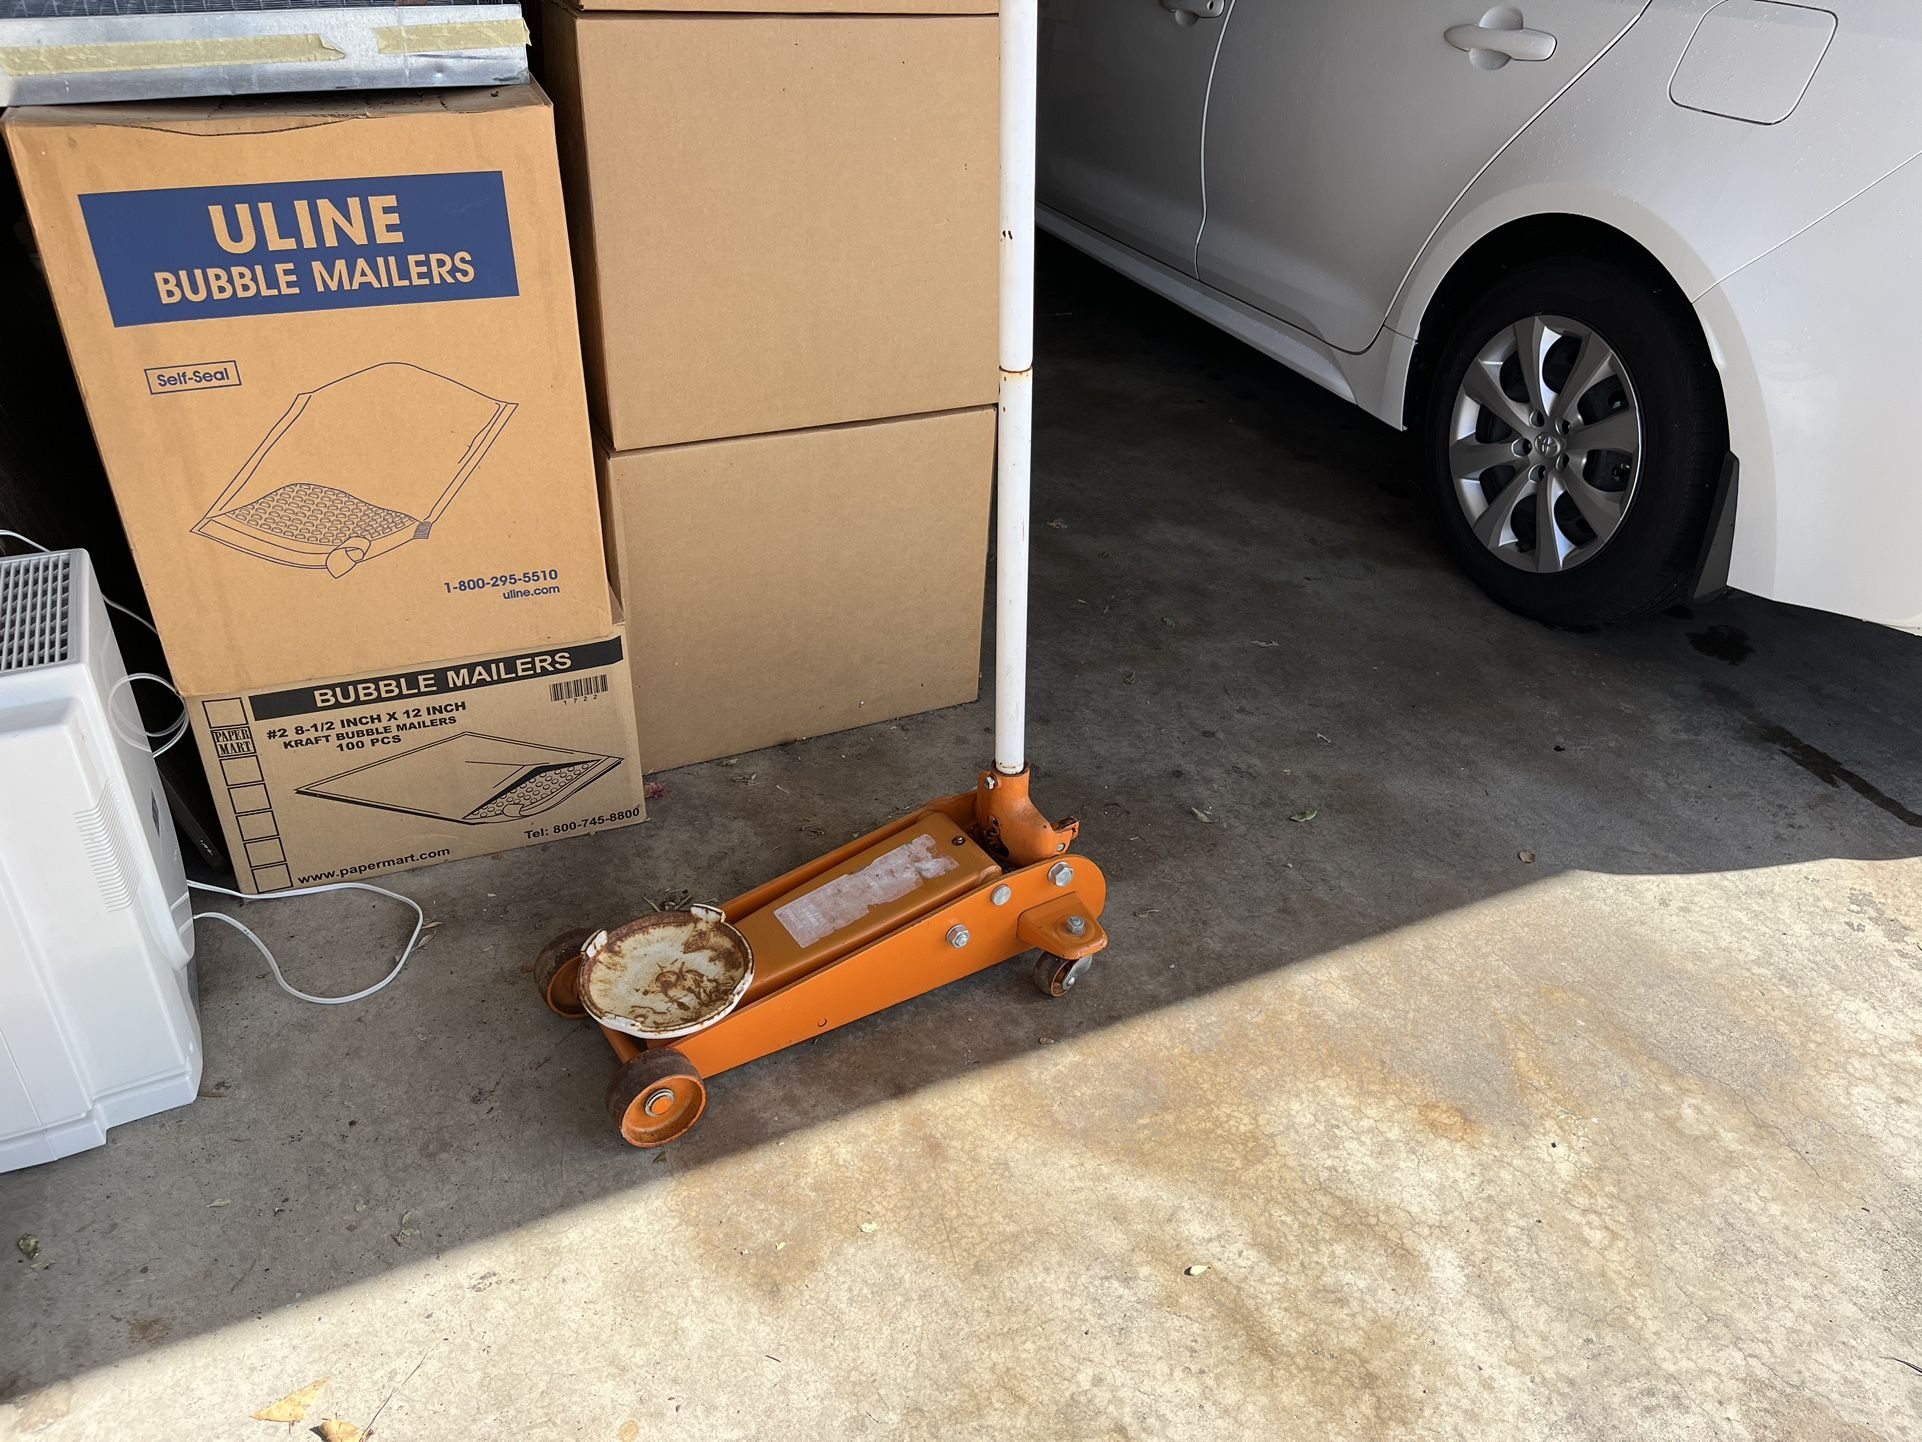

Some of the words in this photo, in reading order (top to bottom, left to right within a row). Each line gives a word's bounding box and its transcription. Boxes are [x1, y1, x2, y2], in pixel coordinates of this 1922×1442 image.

[208, 195, 404, 254] ULINE
[154, 263, 300, 304] BUBBLE
[311, 251, 475, 292] MAILERS
[157, 368, 229, 387] Self-Seal
[444, 569, 558, 593] 1-800-295-5510
[503, 585, 560, 600] uline.com
[313, 673, 437, 707] BUBBLE
[446, 652, 572, 689] MAILERS
[213, 727, 250, 743] PAPER
[267, 728, 288, 740] #2
[295, 721, 335, 736] 8-1/2
[341, 713, 382, 729] INCH
[386, 711, 399, 722] X
[402, 707, 423, 719] 12
[426, 701, 467, 717] INCH
[283, 735, 331, 750] KRAFT
[335, 725, 392, 741] BUBBLE
[395, 716, 457, 732] MAILERS
[219, 740, 252, 756] MART
[336, 739, 364, 752] 100
[370, 734, 402, 747] PCS
[524, 828, 549, 839] Tel:
[553, 807, 640, 834] 800-745-8800
[298, 848, 450, 884] www.papermart.com
